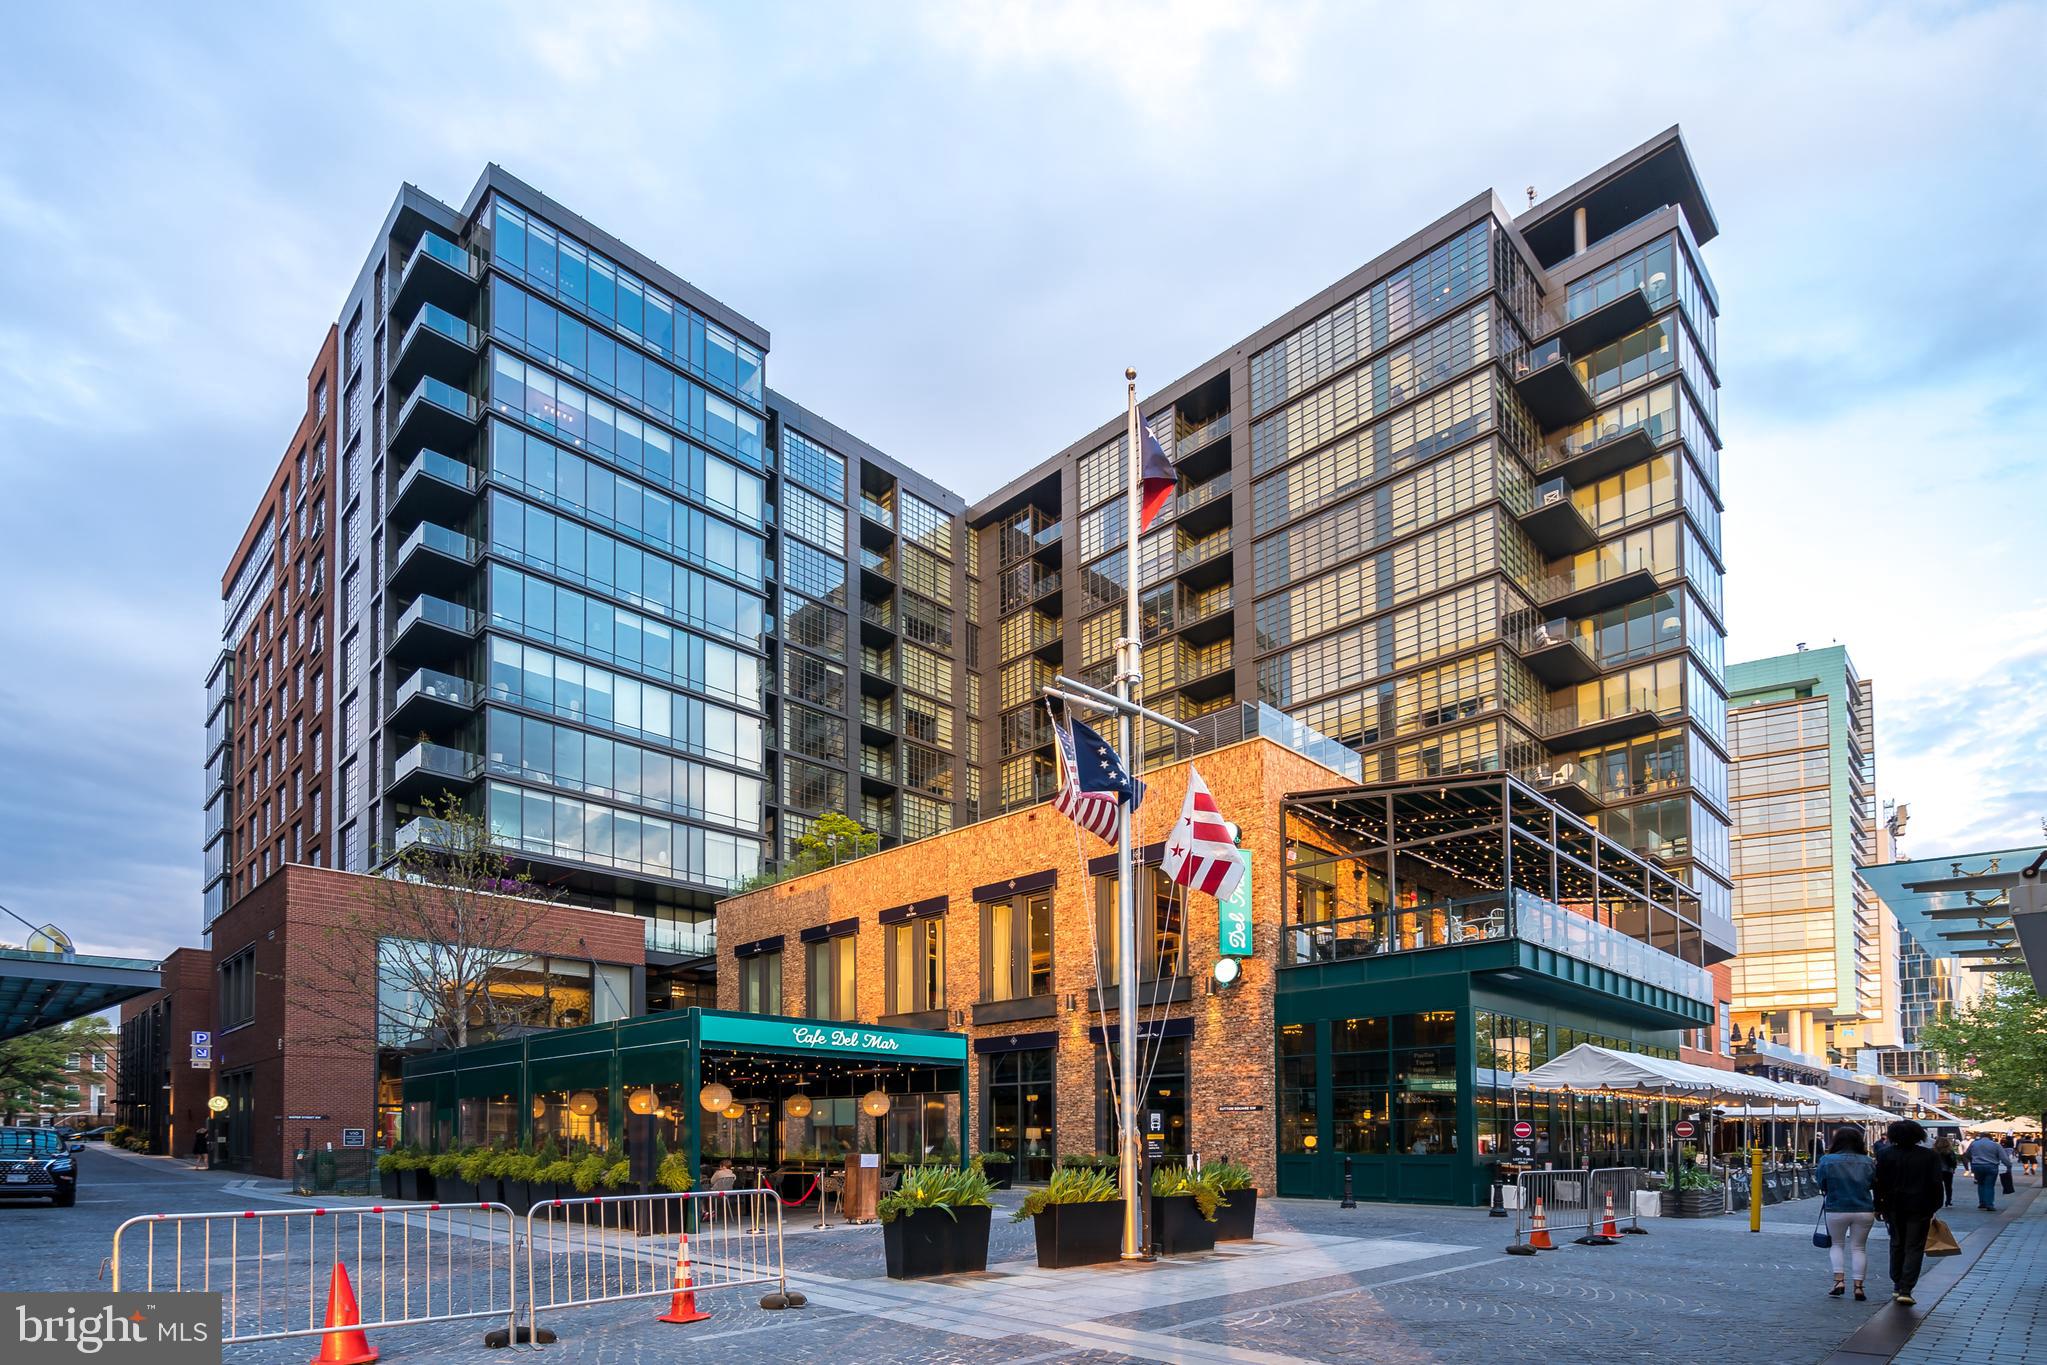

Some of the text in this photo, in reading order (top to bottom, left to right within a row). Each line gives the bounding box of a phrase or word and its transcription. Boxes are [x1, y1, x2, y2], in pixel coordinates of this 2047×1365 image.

[1228, 912, 1246, 949] Del
[196, 1033, 207, 1044] P
[792, 1027, 899, 1050] Cafe Del Mar
